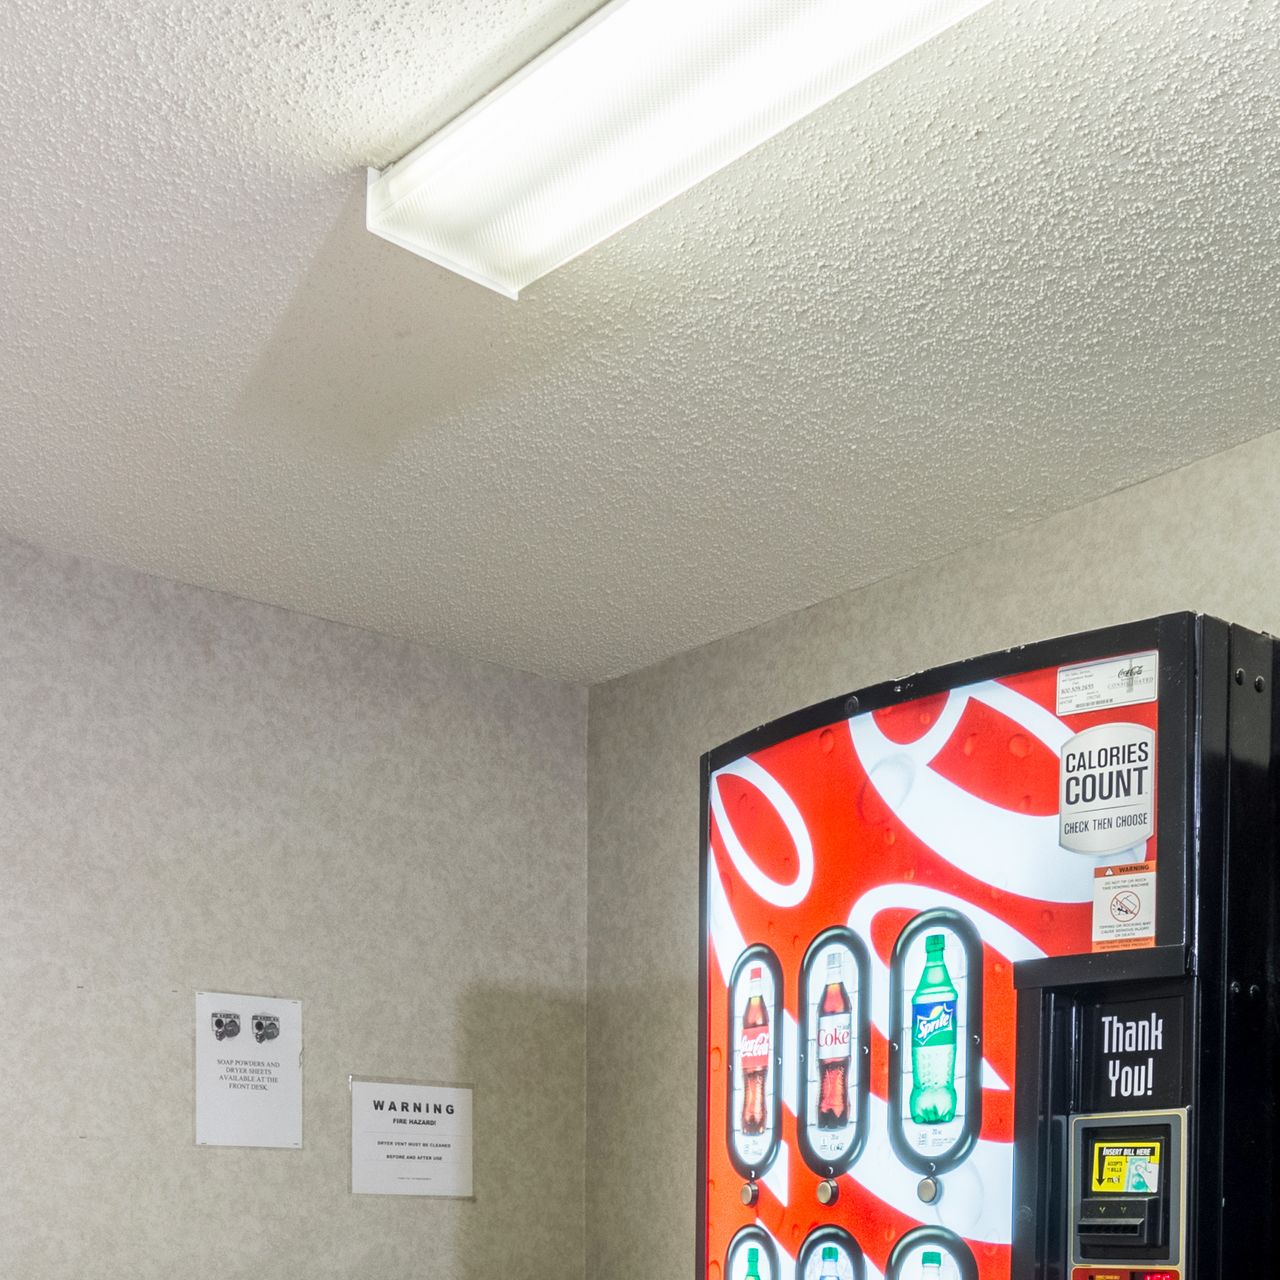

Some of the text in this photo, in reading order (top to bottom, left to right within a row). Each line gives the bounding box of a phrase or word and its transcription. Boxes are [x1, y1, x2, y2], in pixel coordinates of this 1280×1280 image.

[1065, 741, 1149, 773] CALORIES
[1065, 766, 1148, 805] COUNT
[1064, 812, 1147, 835] CHECK THEN CHOOSE
[1118, 864, 1150, 873] WARNING
[917, 1013, 951, 1039] Sprite
[1101, 1012, 1163, 1054] Thank
[816, 1028, 850, 1048] Coke
[219, 1074, 255, 1082] AVAILABLE
[1108, 1057, 1154, 1098] You!
[373, 1099, 455, 1115] WARNING
[1103, 1146, 1123, 1156] INSERT
[1136, 1147, 1151, 1156] HERE
